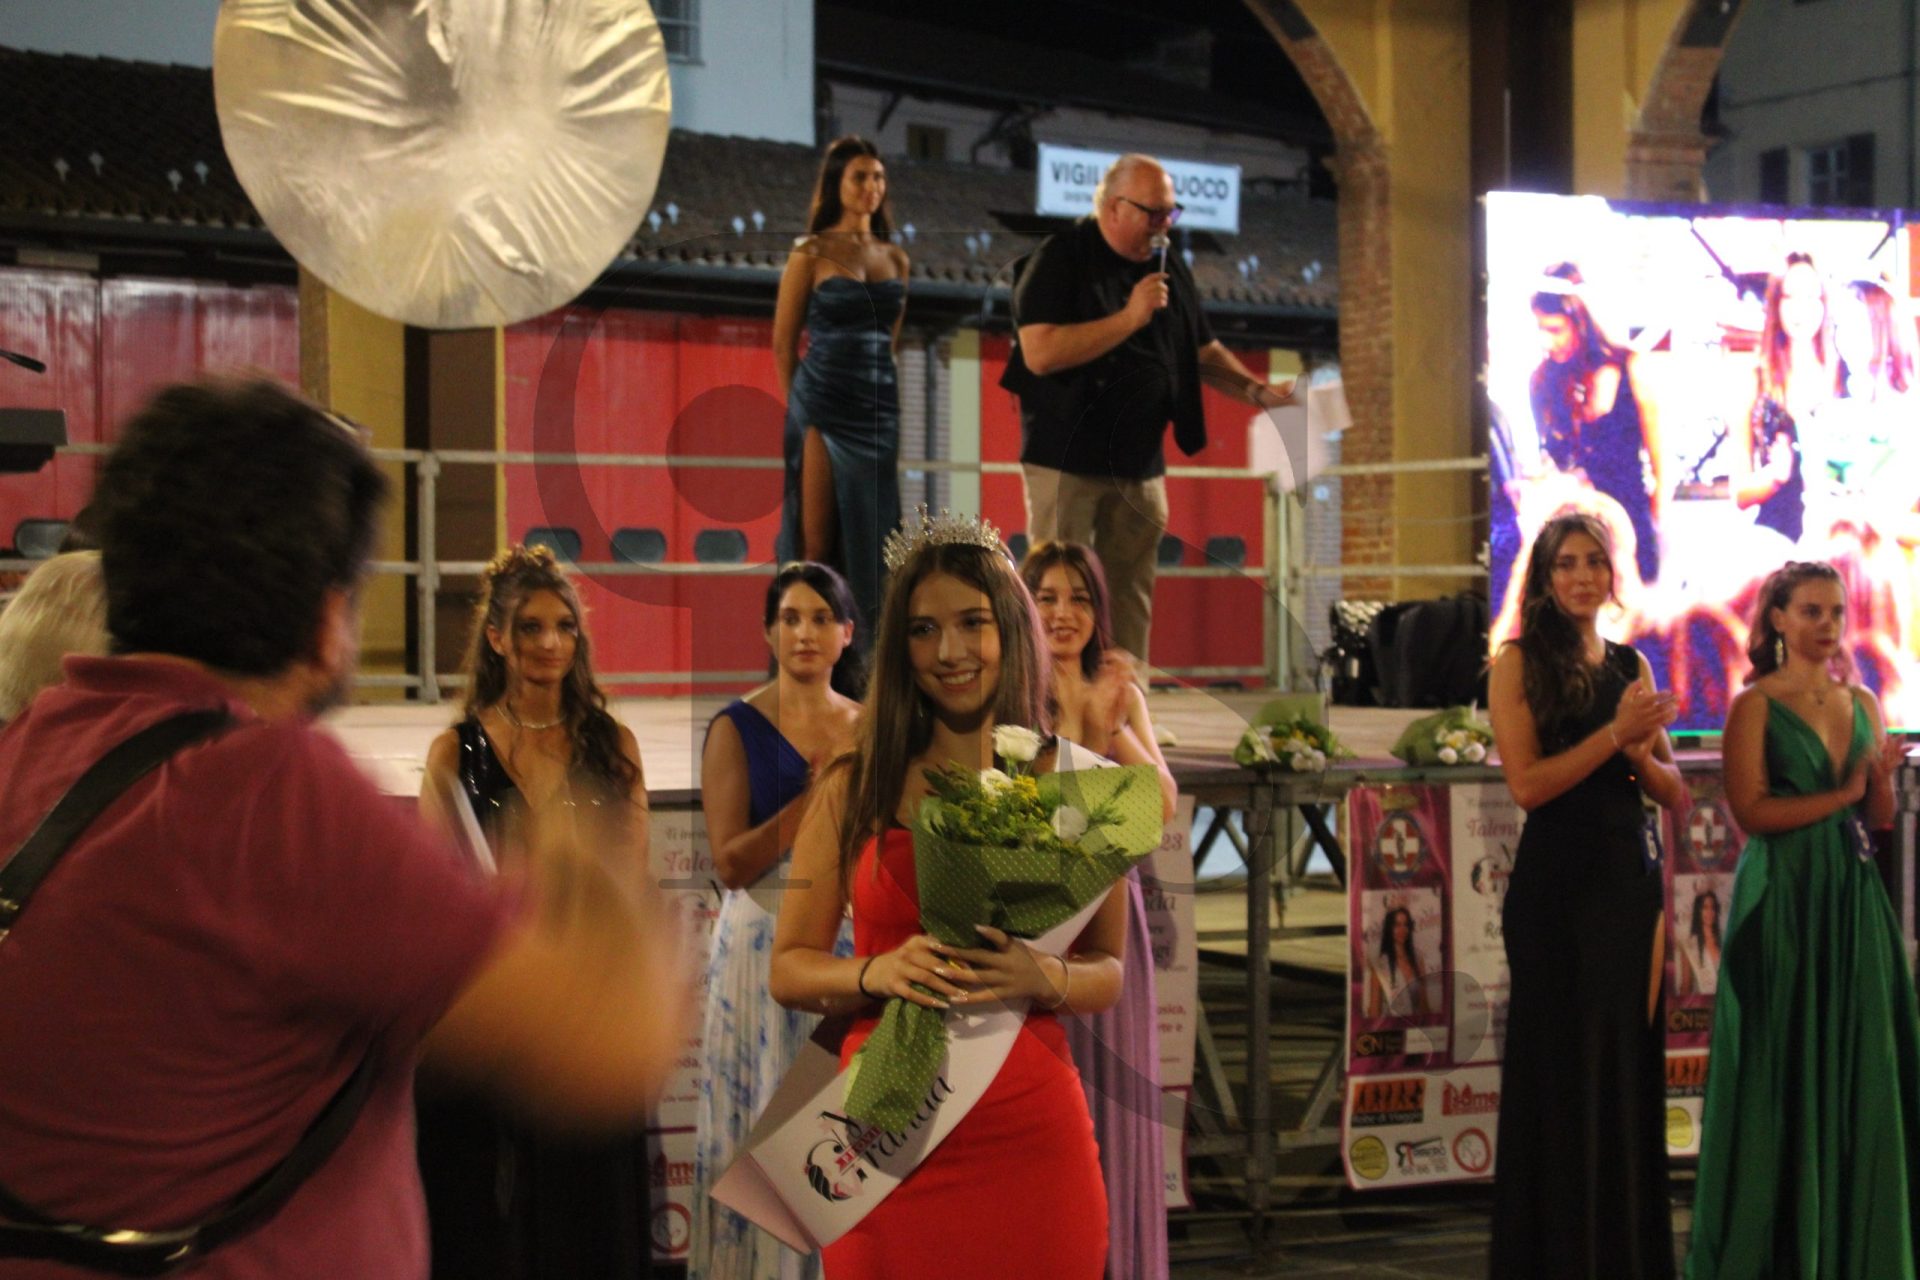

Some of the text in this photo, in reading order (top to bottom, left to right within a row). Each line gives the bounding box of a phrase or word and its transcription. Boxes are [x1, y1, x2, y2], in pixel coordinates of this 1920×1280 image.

[1051, 161, 1229, 200] VIGIL UOCO
[1162, 832, 1184, 852] 23
[664, 848, 715, 873] Tale
